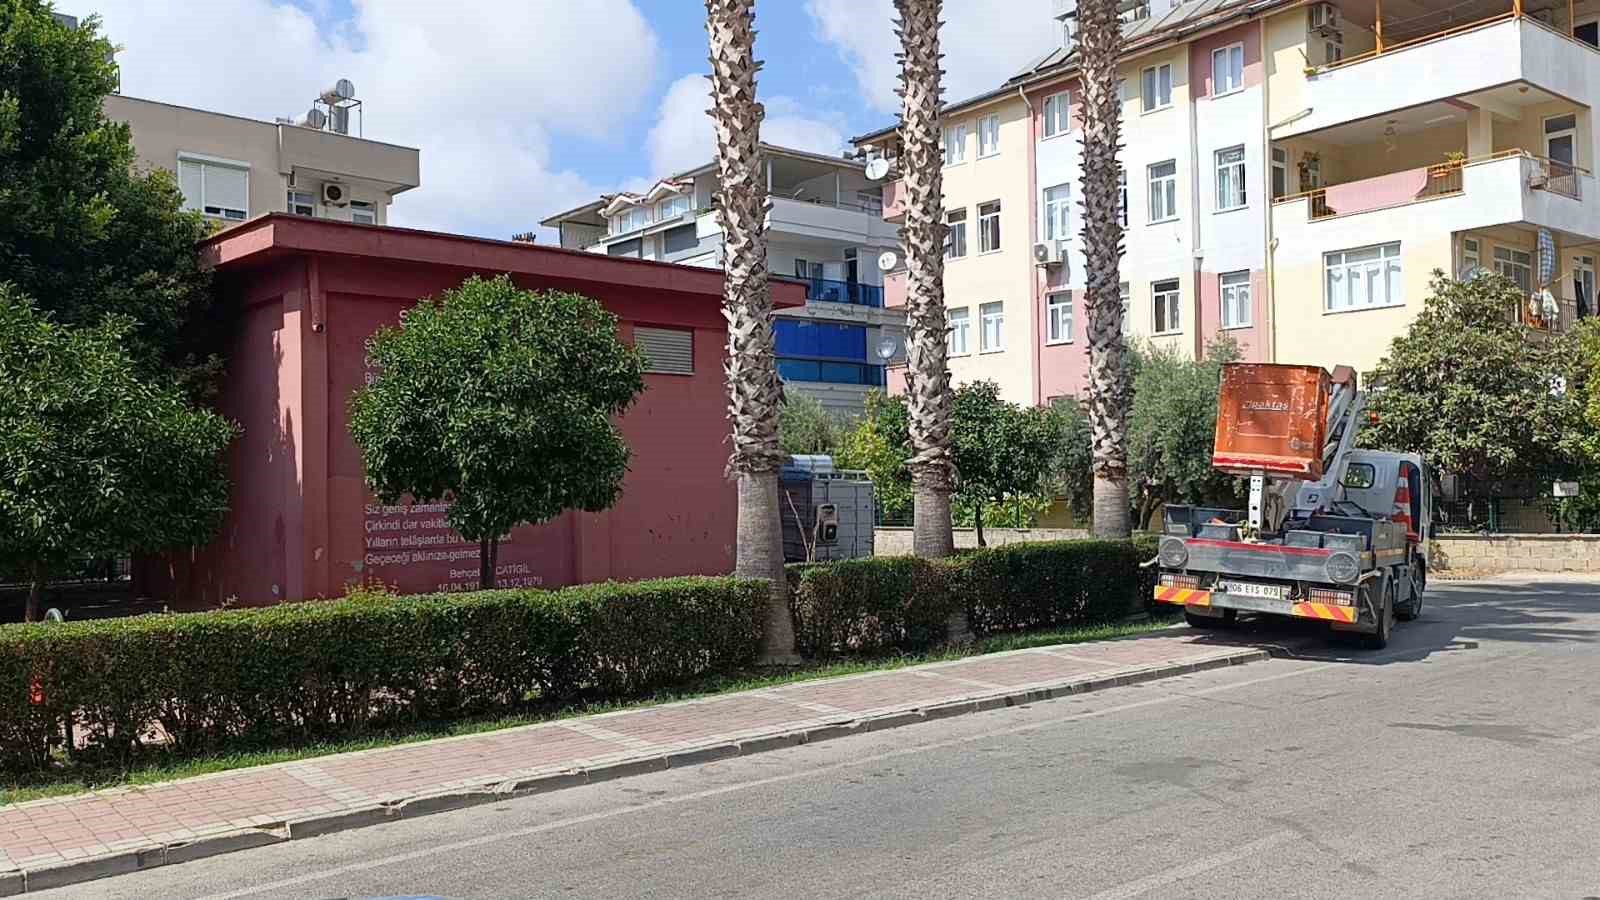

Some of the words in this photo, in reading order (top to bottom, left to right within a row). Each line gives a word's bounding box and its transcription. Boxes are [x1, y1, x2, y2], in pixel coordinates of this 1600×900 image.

[402, 518, 418, 530] dar
[446, 533, 459, 545] bu
[365, 551, 410, 567] Geçeceği
